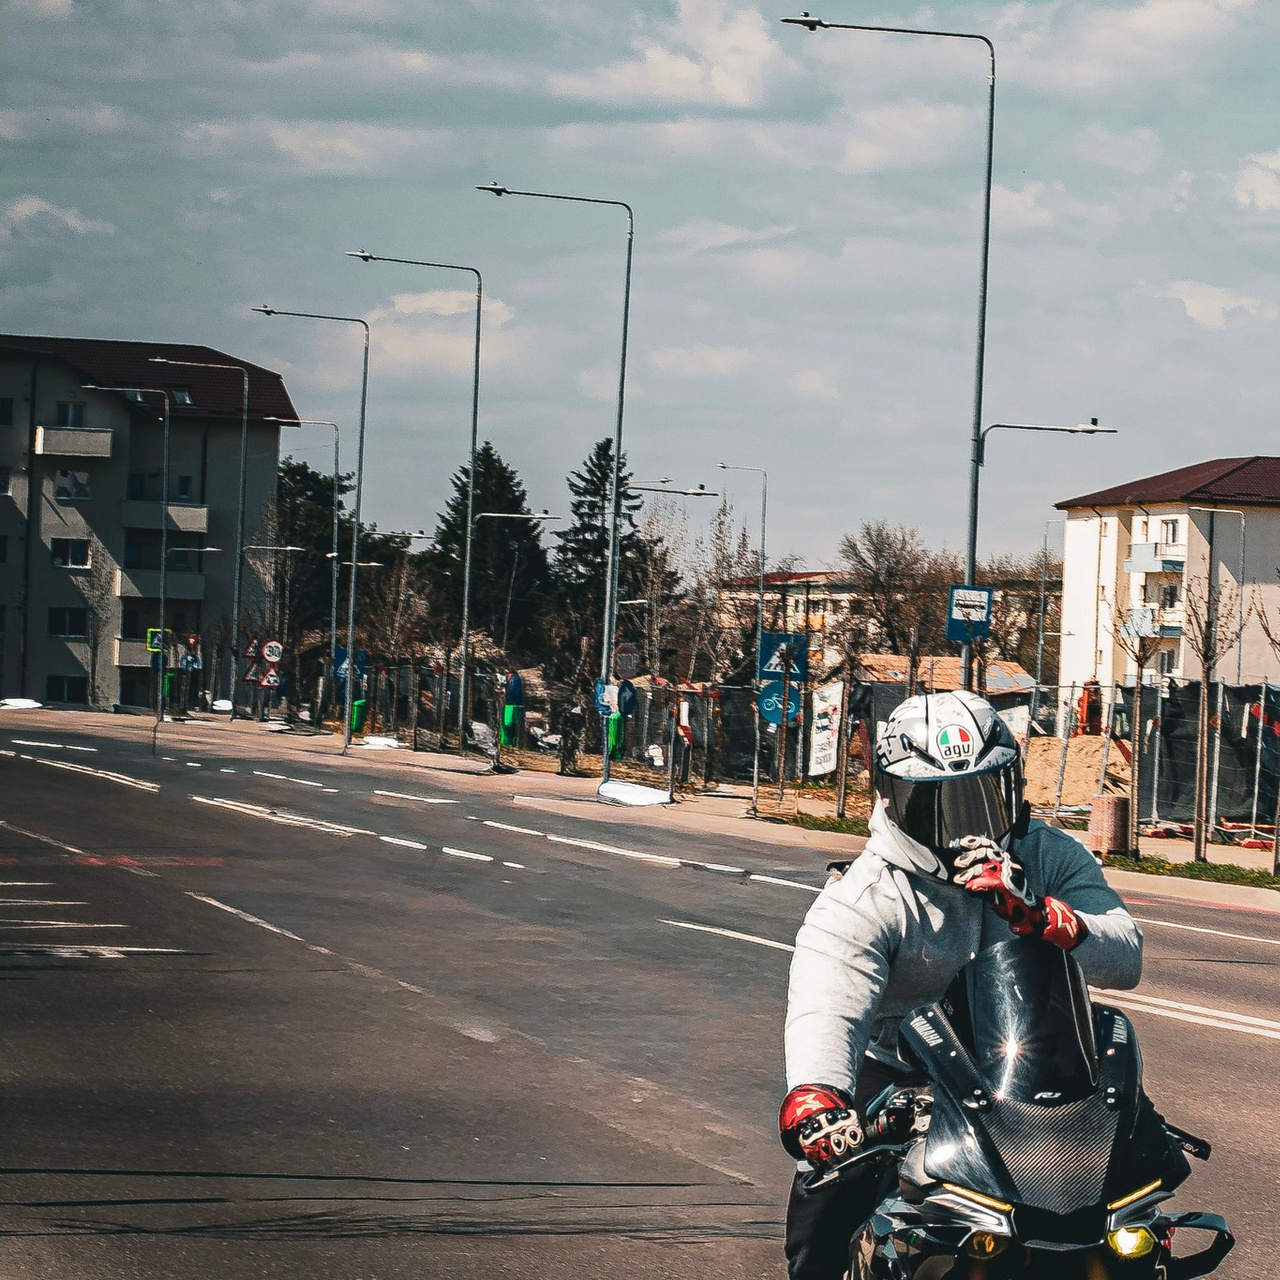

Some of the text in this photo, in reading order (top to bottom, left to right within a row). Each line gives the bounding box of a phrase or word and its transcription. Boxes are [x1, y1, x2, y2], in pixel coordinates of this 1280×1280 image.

[944, 743, 971, 758] agv
[909, 1015, 944, 1047] YAMAHA
[1112, 1015, 1128, 1044] YAMAHA
